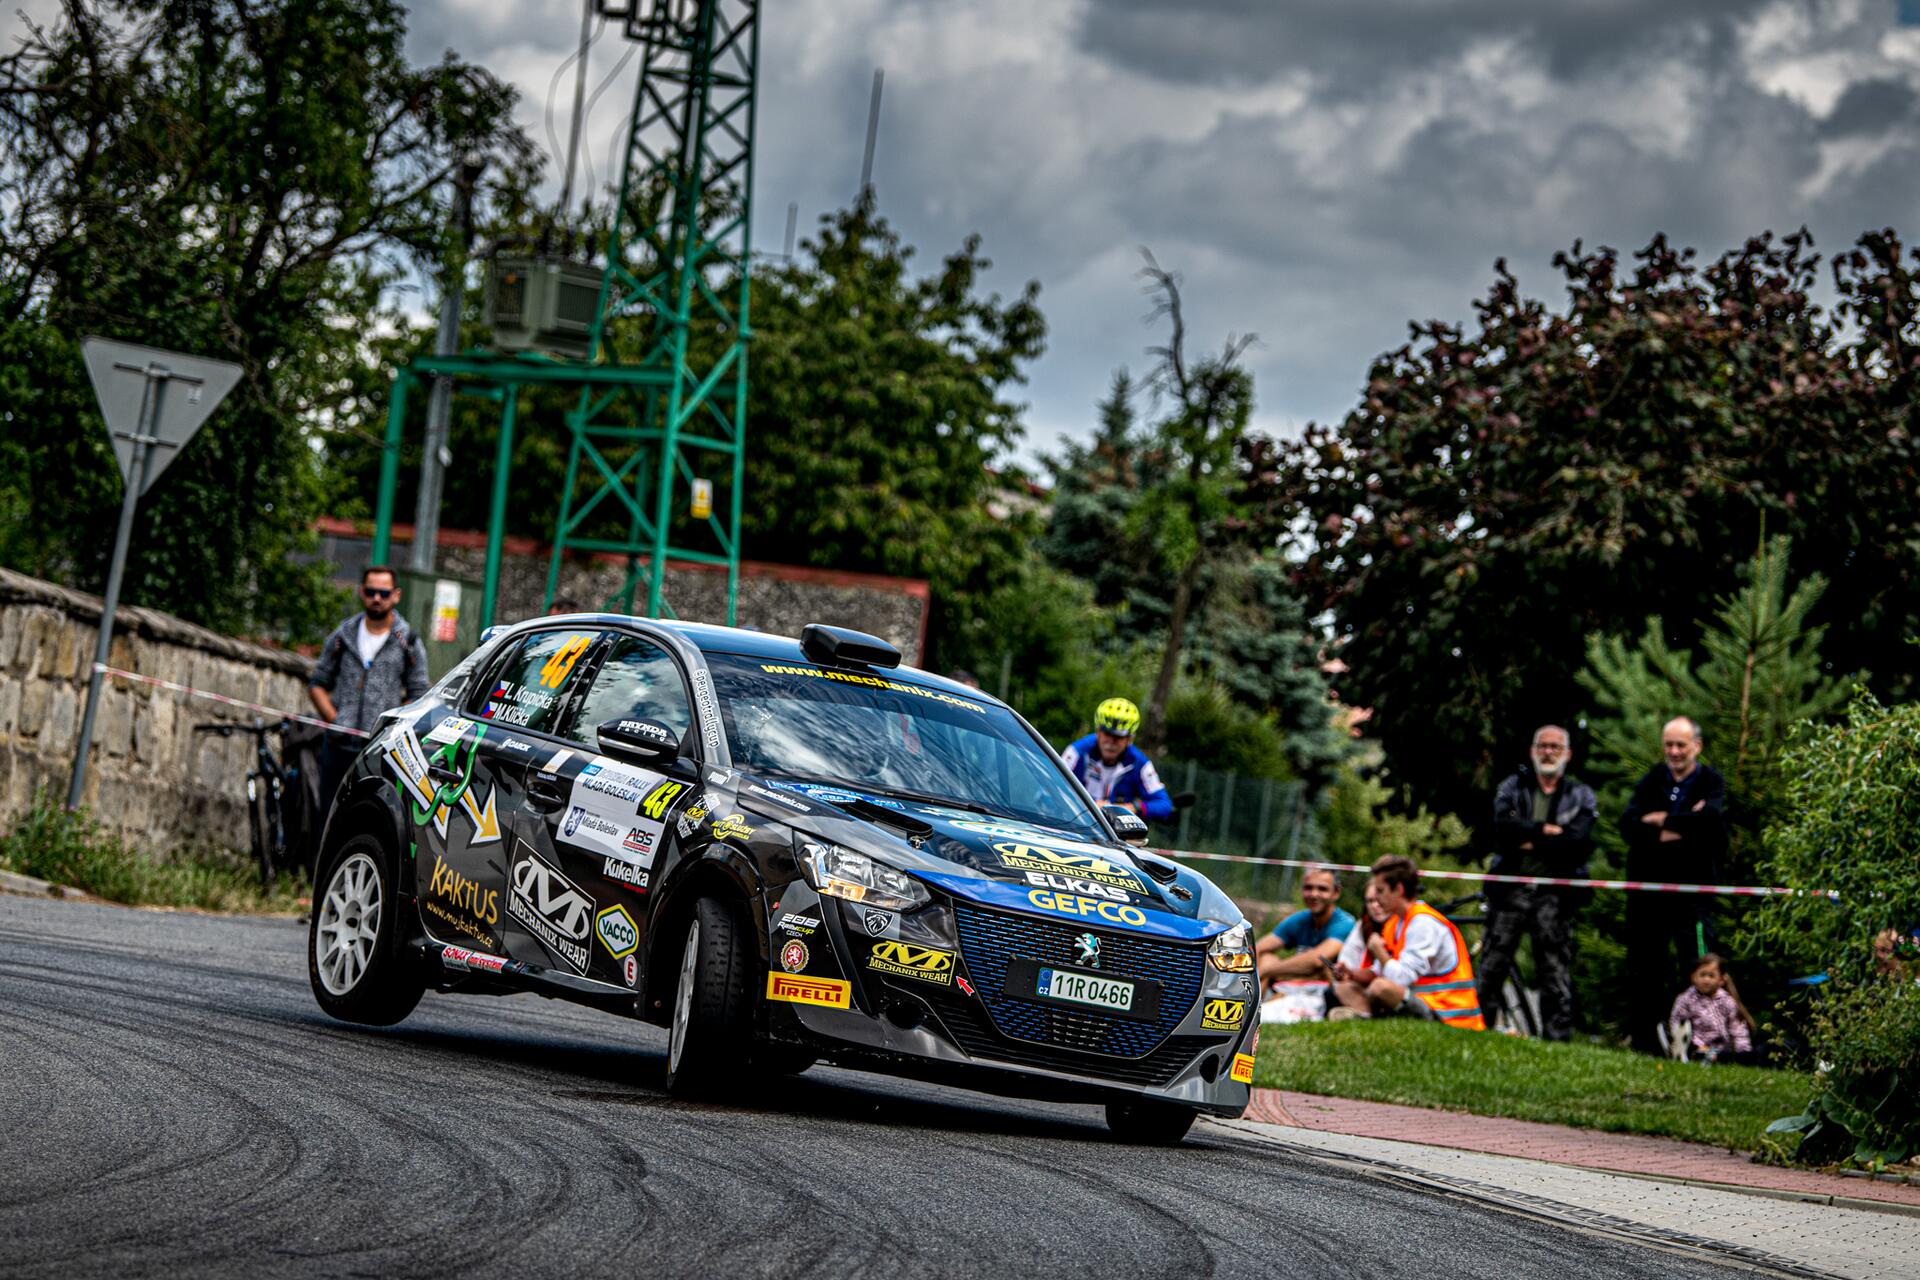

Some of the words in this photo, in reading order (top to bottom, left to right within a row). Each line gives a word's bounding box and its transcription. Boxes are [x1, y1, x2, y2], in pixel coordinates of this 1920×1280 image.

[539, 635, 592, 689] 43
[513, 685, 554, 709] Krupička
[761, 664, 986, 714] www.mechanix.com
[493, 703, 530, 727] M.Klička
[693, 669, 719, 748] @peugeotrallycup
[617, 727, 666, 742] racing
[583, 778, 608, 796] MLADÁ
[605, 785, 640, 803] BOLESLAV
[626, 778, 651, 791] RALLY
[643, 781, 682, 819] 43
[748, 784, 811, 812] www.mechanix.com
[581, 816, 598, 831] Mladá
[597, 819, 619, 836] Boleslav
[626, 827, 656, 846] ABS
[603, 857, 649, 887] Kukelka
[1002, 855, 1091, 879] MECHANIX
[1093, 873, 1141, 891] WEAR
[430, 856, 498, 925] KAKTUS
[1025, 871, 1130, 902] ELKAS
[1028, 889, 1147, 926] GEFCO
[426, 902, 493, 948] www.mujkaktus.cz
[508, 890, 558, 946] MECHANIX
[559, 939, 589, 969] WEAR
[602, 918, 633, 945] YACCO
[781, 913, 821, 928] 208
[786, 930, 803, 938] CZECH
[443, 947, 470, 961] SONAX
[869, 957, 918, 977] MECHANIX
[919, 970, 948, 983] WEAR
[774, 977, 843, 1002] PIRELLI
[1038, 987, 1049, 995] CZ
[1088, 981, 1131, 1006] 0466
[1202, 1018, 1229, 1030] MECHANIX
